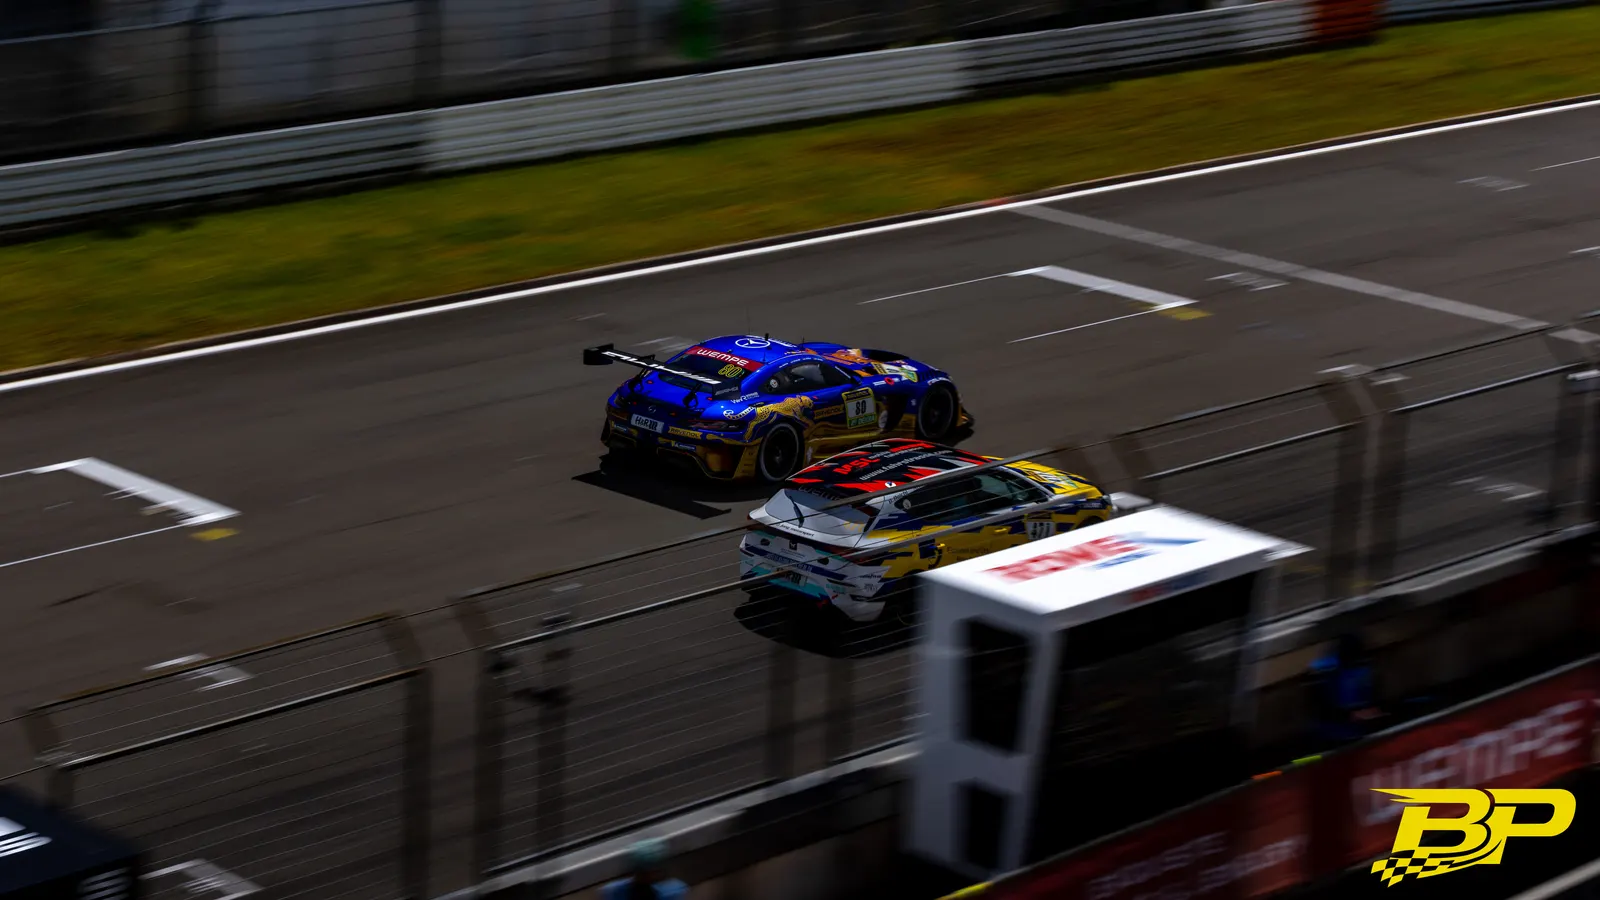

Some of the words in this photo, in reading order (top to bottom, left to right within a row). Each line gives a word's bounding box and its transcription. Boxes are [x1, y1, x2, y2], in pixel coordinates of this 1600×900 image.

[697, 348, 750, 367] WEMPE
[718, 364, 743, 379] 80
[855, 400, 867, 416] 80
